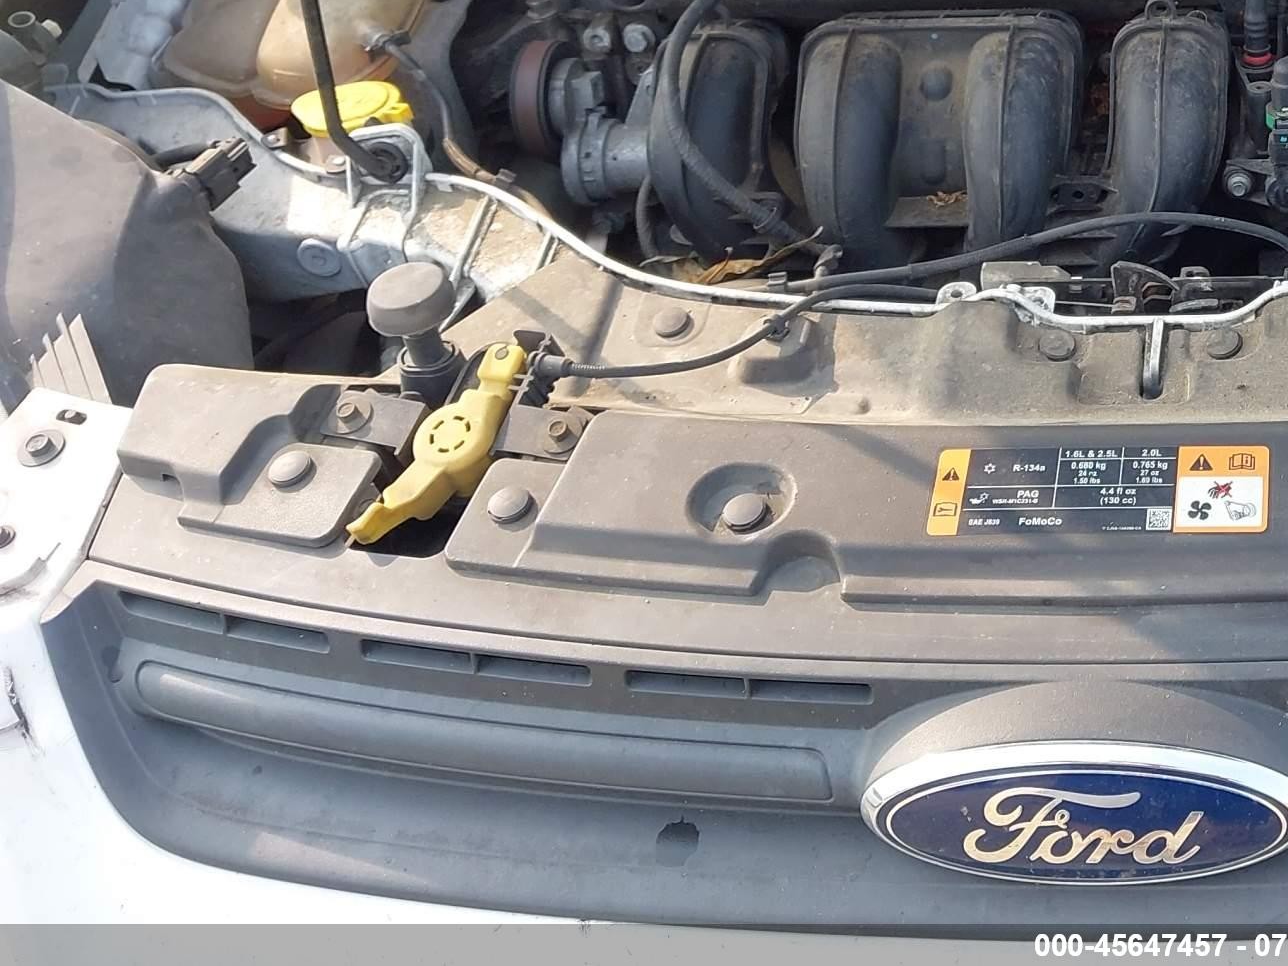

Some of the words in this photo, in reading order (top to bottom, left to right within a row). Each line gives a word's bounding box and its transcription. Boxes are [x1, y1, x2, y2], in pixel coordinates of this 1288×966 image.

[1065, 450, 1085, 458] 1.6L
[1087, 450, 1095, 458] &
[1097, 449, 1118, 457] 2.5L
[1141, 449, 1162, 457] 2.0L
[1012, 463, 1046, 472] R-134a
[1095, 461, 1106, 471] kg
[1132, 460, 1155, 469] 0.765
[1157, 461, 1168, 470] kg
[1016, 489, 1039, 498] PAG
[1099, 488, 1115, 496] 4.4
[1116, 487, 1124, 495] fl
[1100, 496, 1119, 505] (130
[1120, 496, 1136, 505] cc)
[1018, 517, 1062, 526] FoMoCo
[963, 787, 1204, 864] Ford
